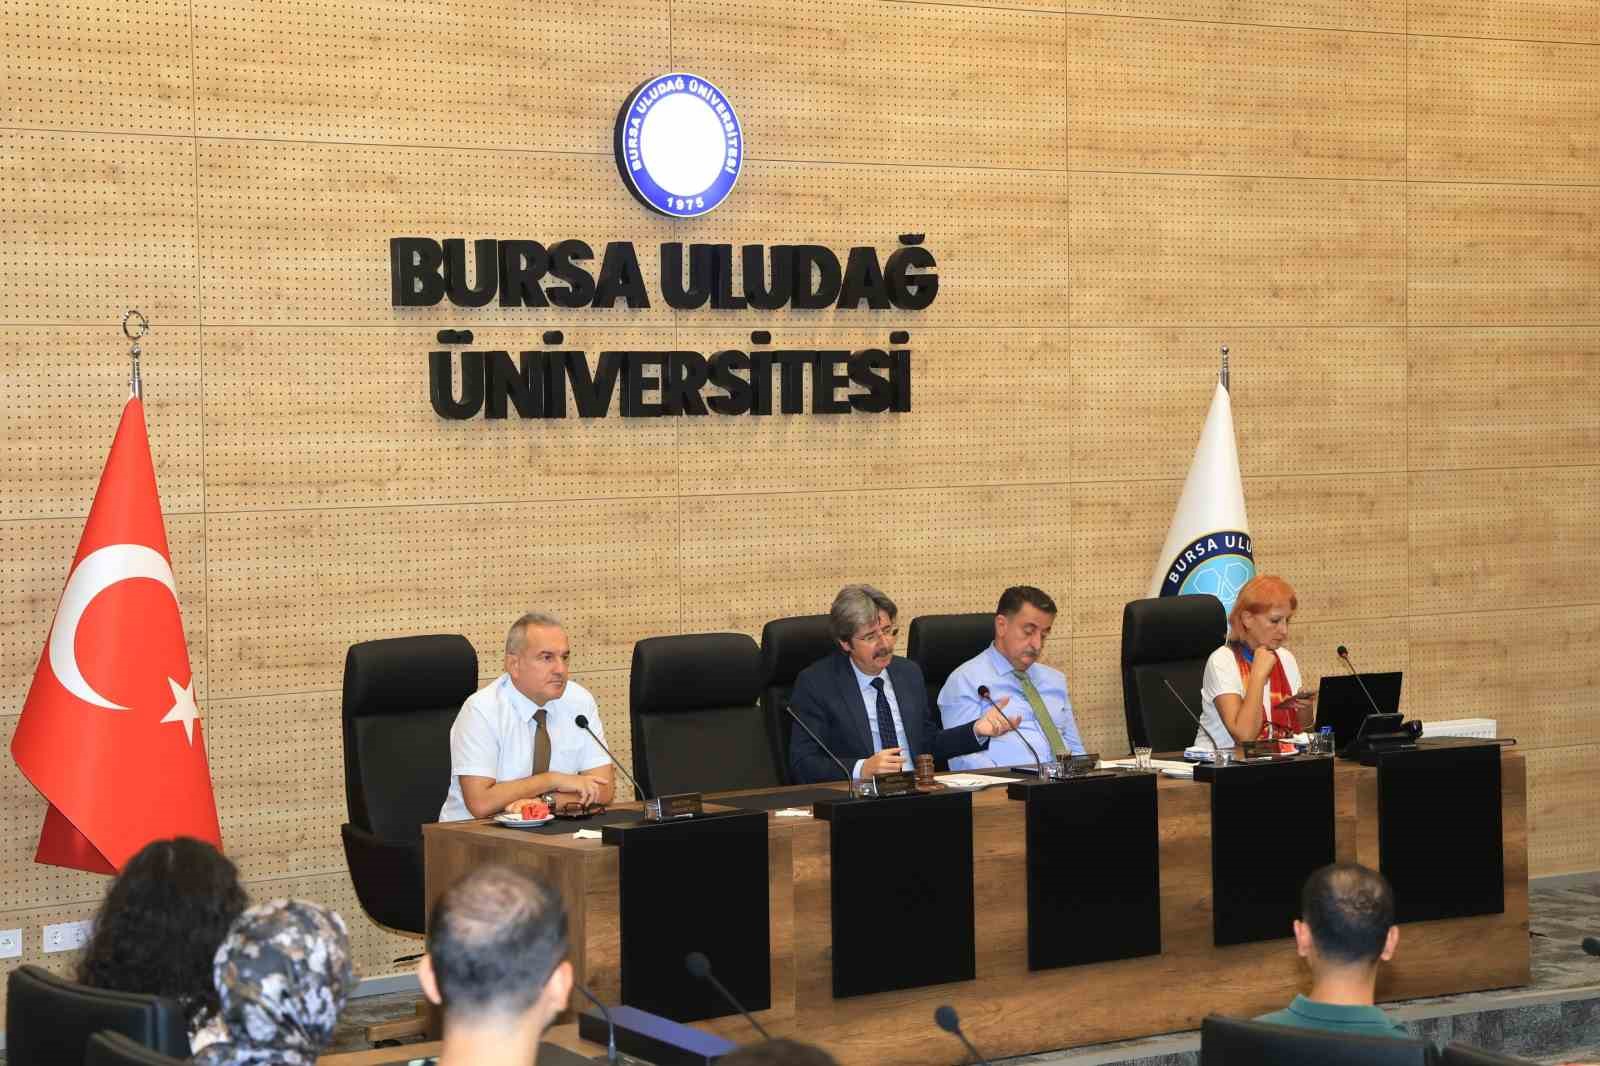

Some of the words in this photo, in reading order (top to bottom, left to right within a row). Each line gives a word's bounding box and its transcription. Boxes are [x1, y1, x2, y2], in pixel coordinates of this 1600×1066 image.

[628, 118, 643, 171] BURSA
[636, 77, 685, 114] ULUDAĞ
[689, 79, 738, 174] ÜNİVERSİTESİ
[667, 198, 705, 210] 1975
[390, 237, 650, 308] BURSA
[660, 234, 939, 310] ULUDAĞ
[429, 330, 911, 419] ÜNİVERSİTESİ
[1169, 538, 1218, 583] BURSA
